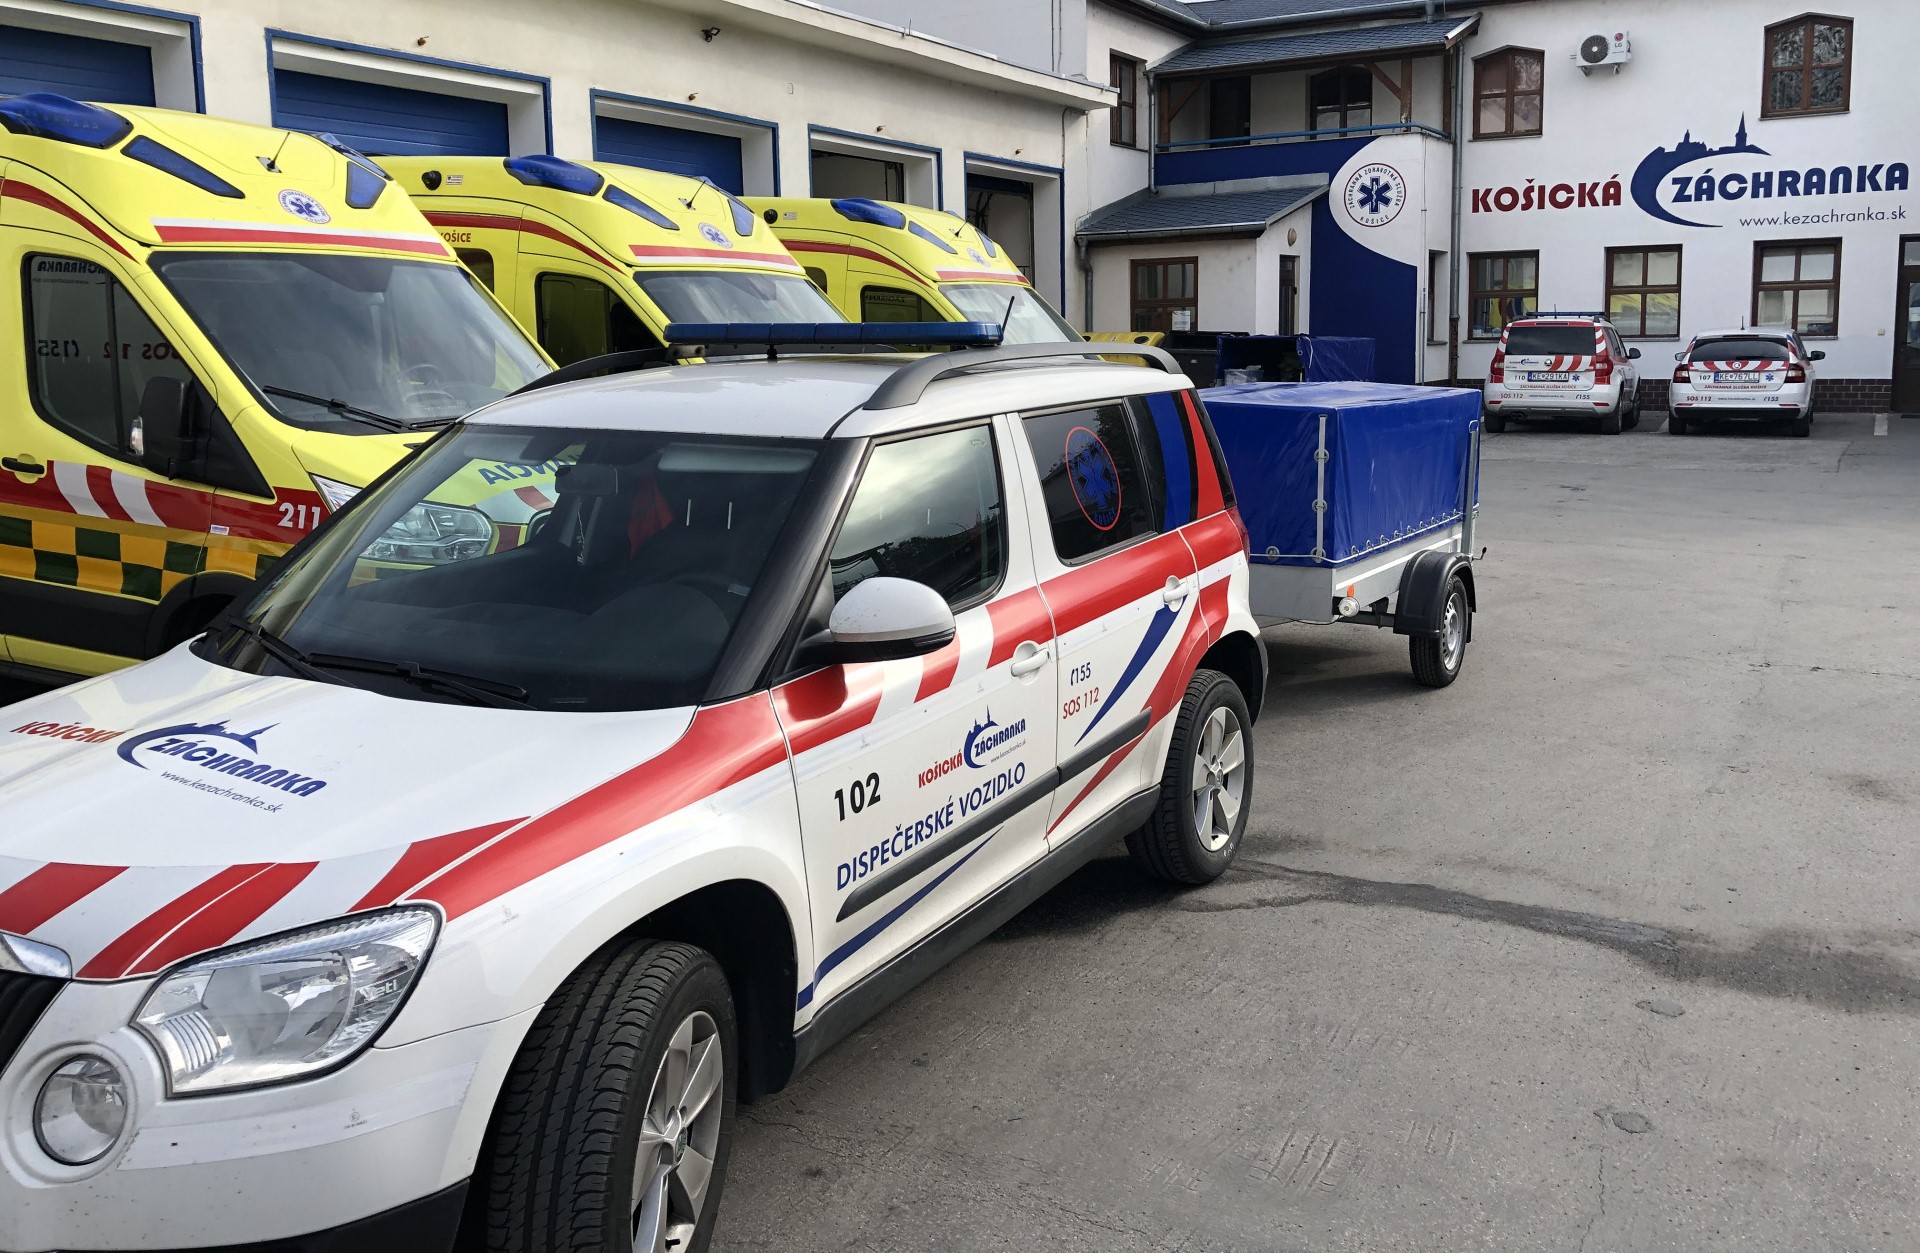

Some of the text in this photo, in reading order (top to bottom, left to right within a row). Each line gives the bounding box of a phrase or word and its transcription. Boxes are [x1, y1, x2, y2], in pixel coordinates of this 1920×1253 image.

[1471, 162, 1909, 213] KOŠICKÁ ZÁCHRANKA
[441, 230, 471, 242] OŠICE
[1739, 205, 1907, 227] www.kezachranka.sk
[277, 502, 320, 530] 211
[1063, 687, 1099, 719] SOS 112
[9, 720, 327, 797] KOŠICKÁ ZÁCHRANKA
[918, 718, 1026, 789] KOŠICKÁ ZÁCHRANKA
[161, 771, 284, 813] www.kezachranka.sk
[834, 772, 881, 821] 102
[836, 761, 1026, 891] DISPEČERSKÉ VOZIDLO
